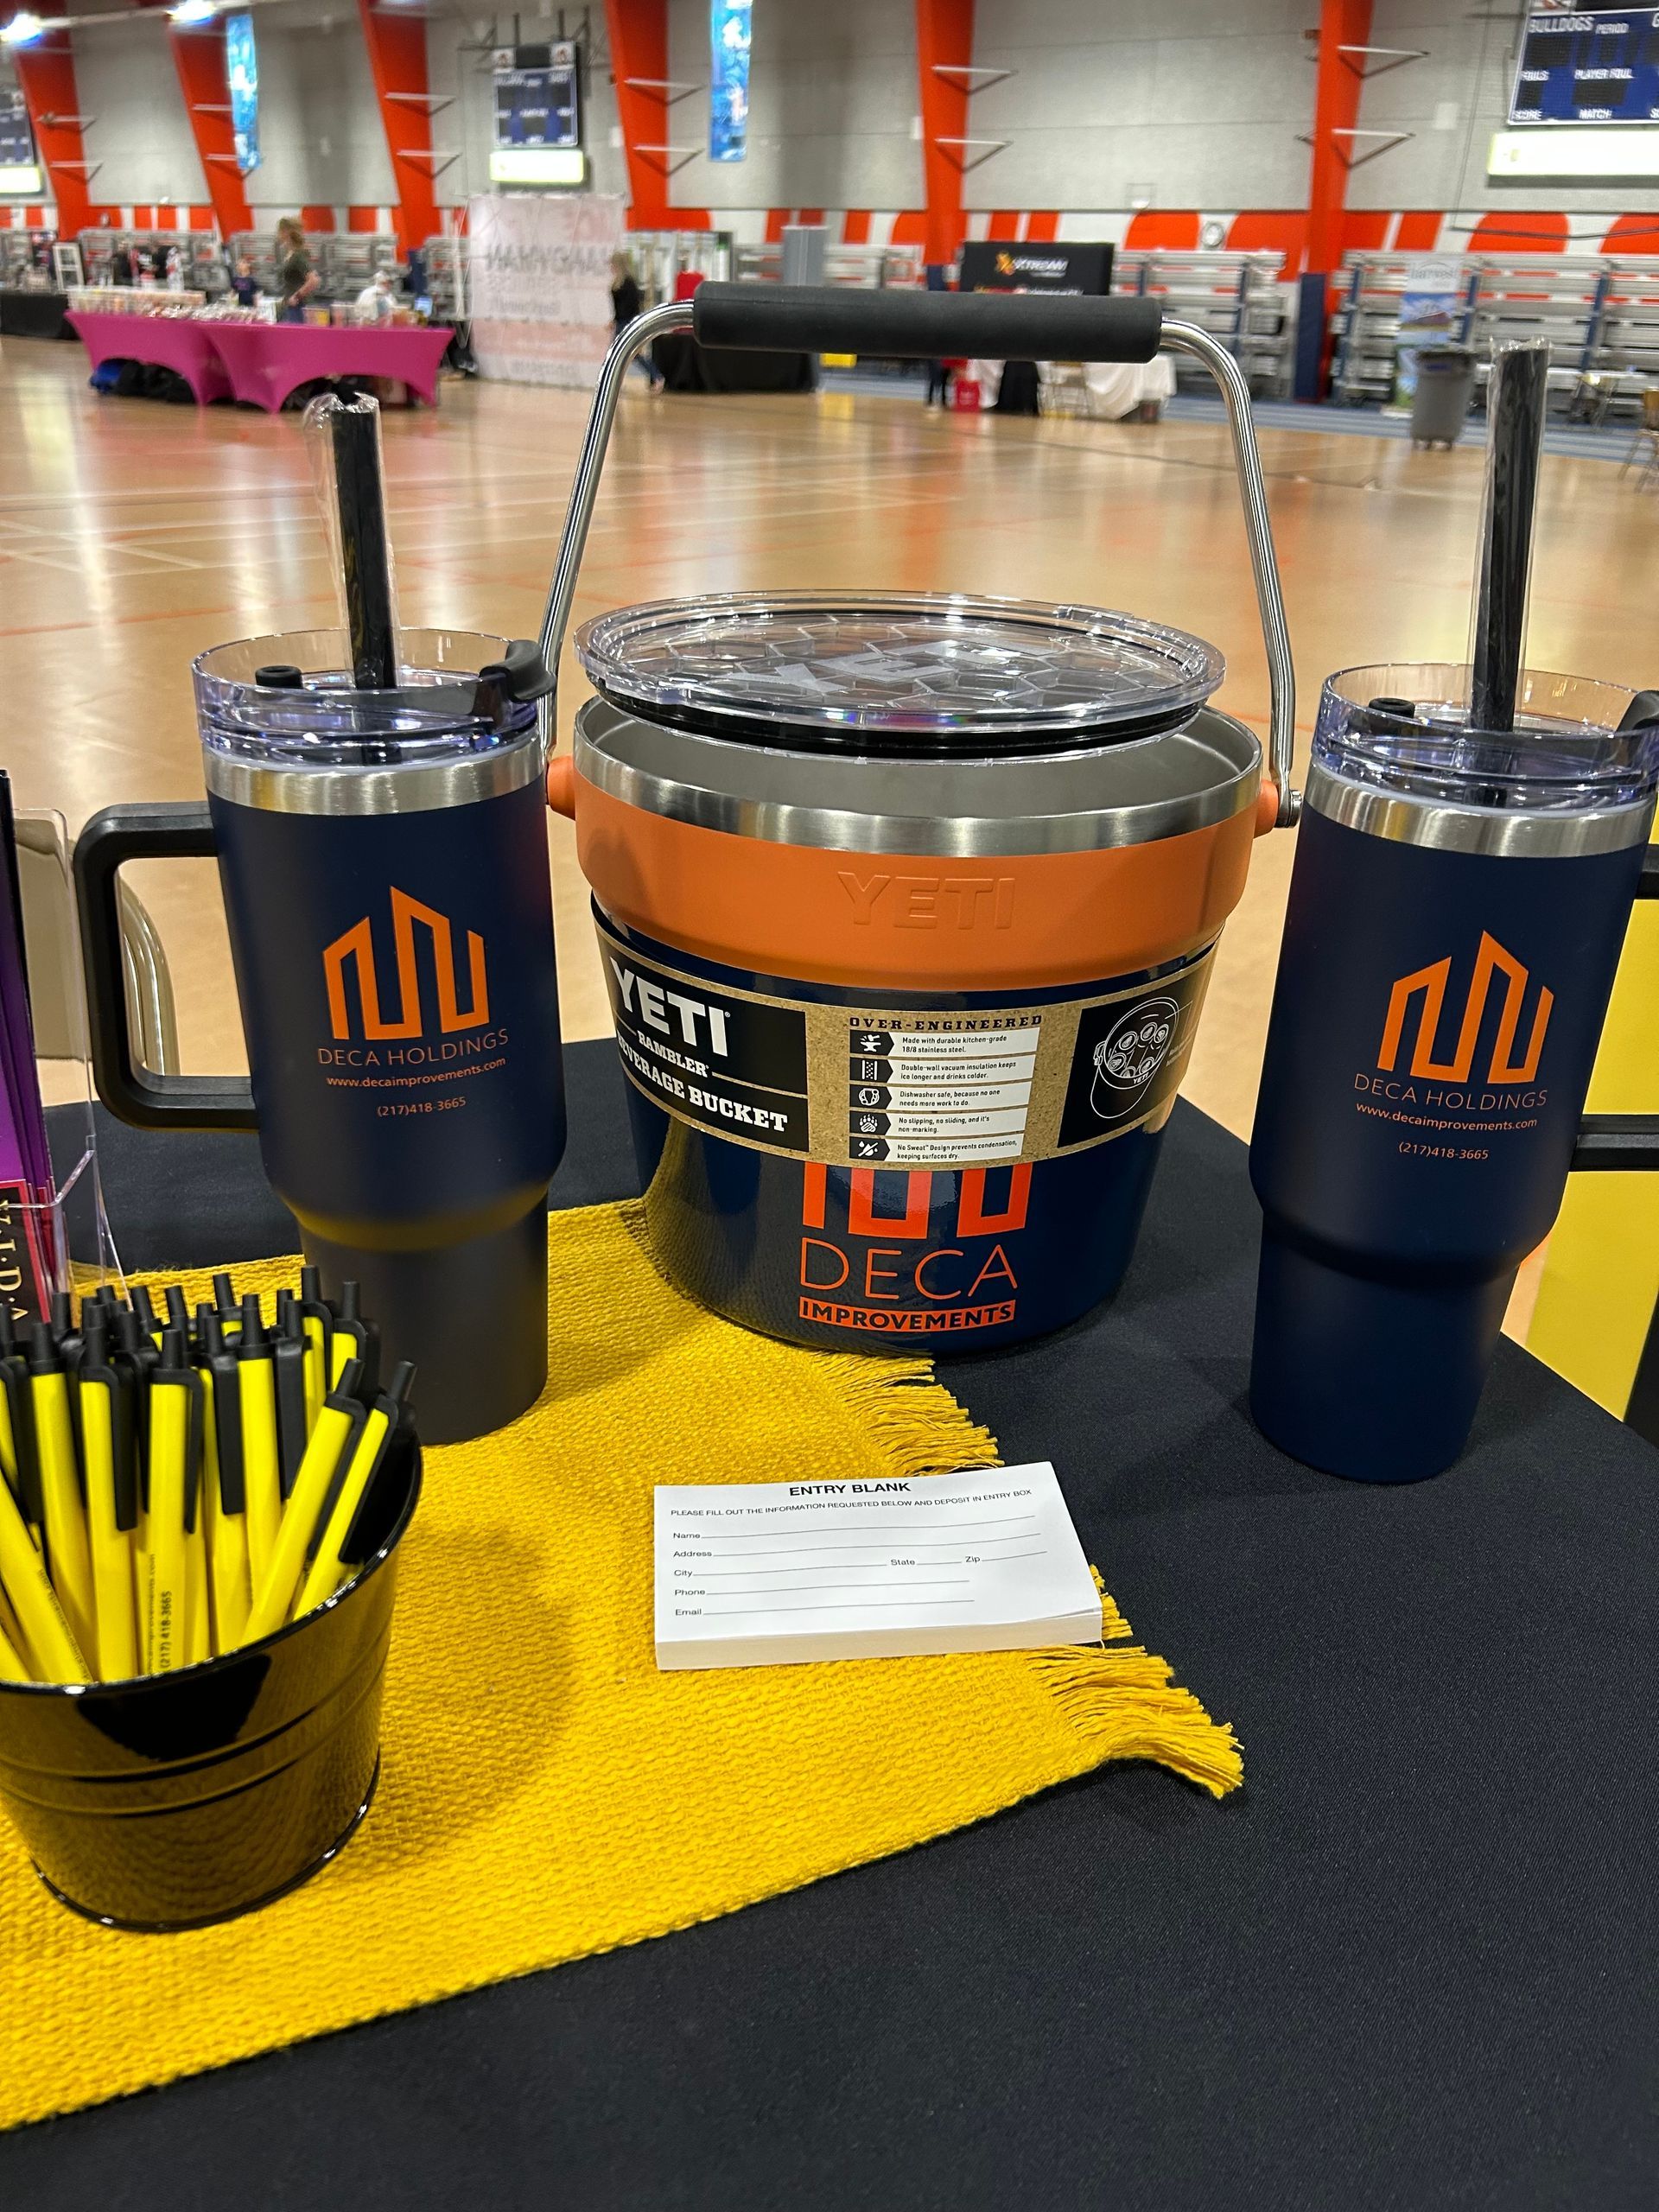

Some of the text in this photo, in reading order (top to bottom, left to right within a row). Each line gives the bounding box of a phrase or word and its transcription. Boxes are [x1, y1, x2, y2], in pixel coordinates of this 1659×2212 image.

[1528, 16, 1594, 33] BULLDOGS
[836, 870, 1016, 931] YETI
[849, 1014, 1042, 1030] OVER-ENGINEERED
[317, 1028, 509, 1066] DECA HOLDINGS
[963, 1034, 1007, 1044] kitchen-grade
[326, 1056, 506, 1089] www.decaimprovements.com
[1354, 1072, 1548, 1110] DECA HOLDINGS
[377, 1096, 467, 1117] (217)418-3665
[688, 1084, 788, 1132] BUCKET
[1356, 1103, 1538, 1131] www.decaimprovements.com
[951, 1143, 977, 1152] prevents
[1398, 1141, 1489, 1160] (217)418-3665
[800, 1236, 1018, 1300] DECA
[802, 1300, 1013, 1330] IMPROVEMENTS
[789, 1482, 912, 1496] ENTRY BLANK
[765, 1502, 825, 1513] INFORMATION
[827, 1500, 879, 1509] REQUESTED
[934, 1497, 970, 1505] DEPOSIT
[983, 1491, 1011, 1500] ENTRY
